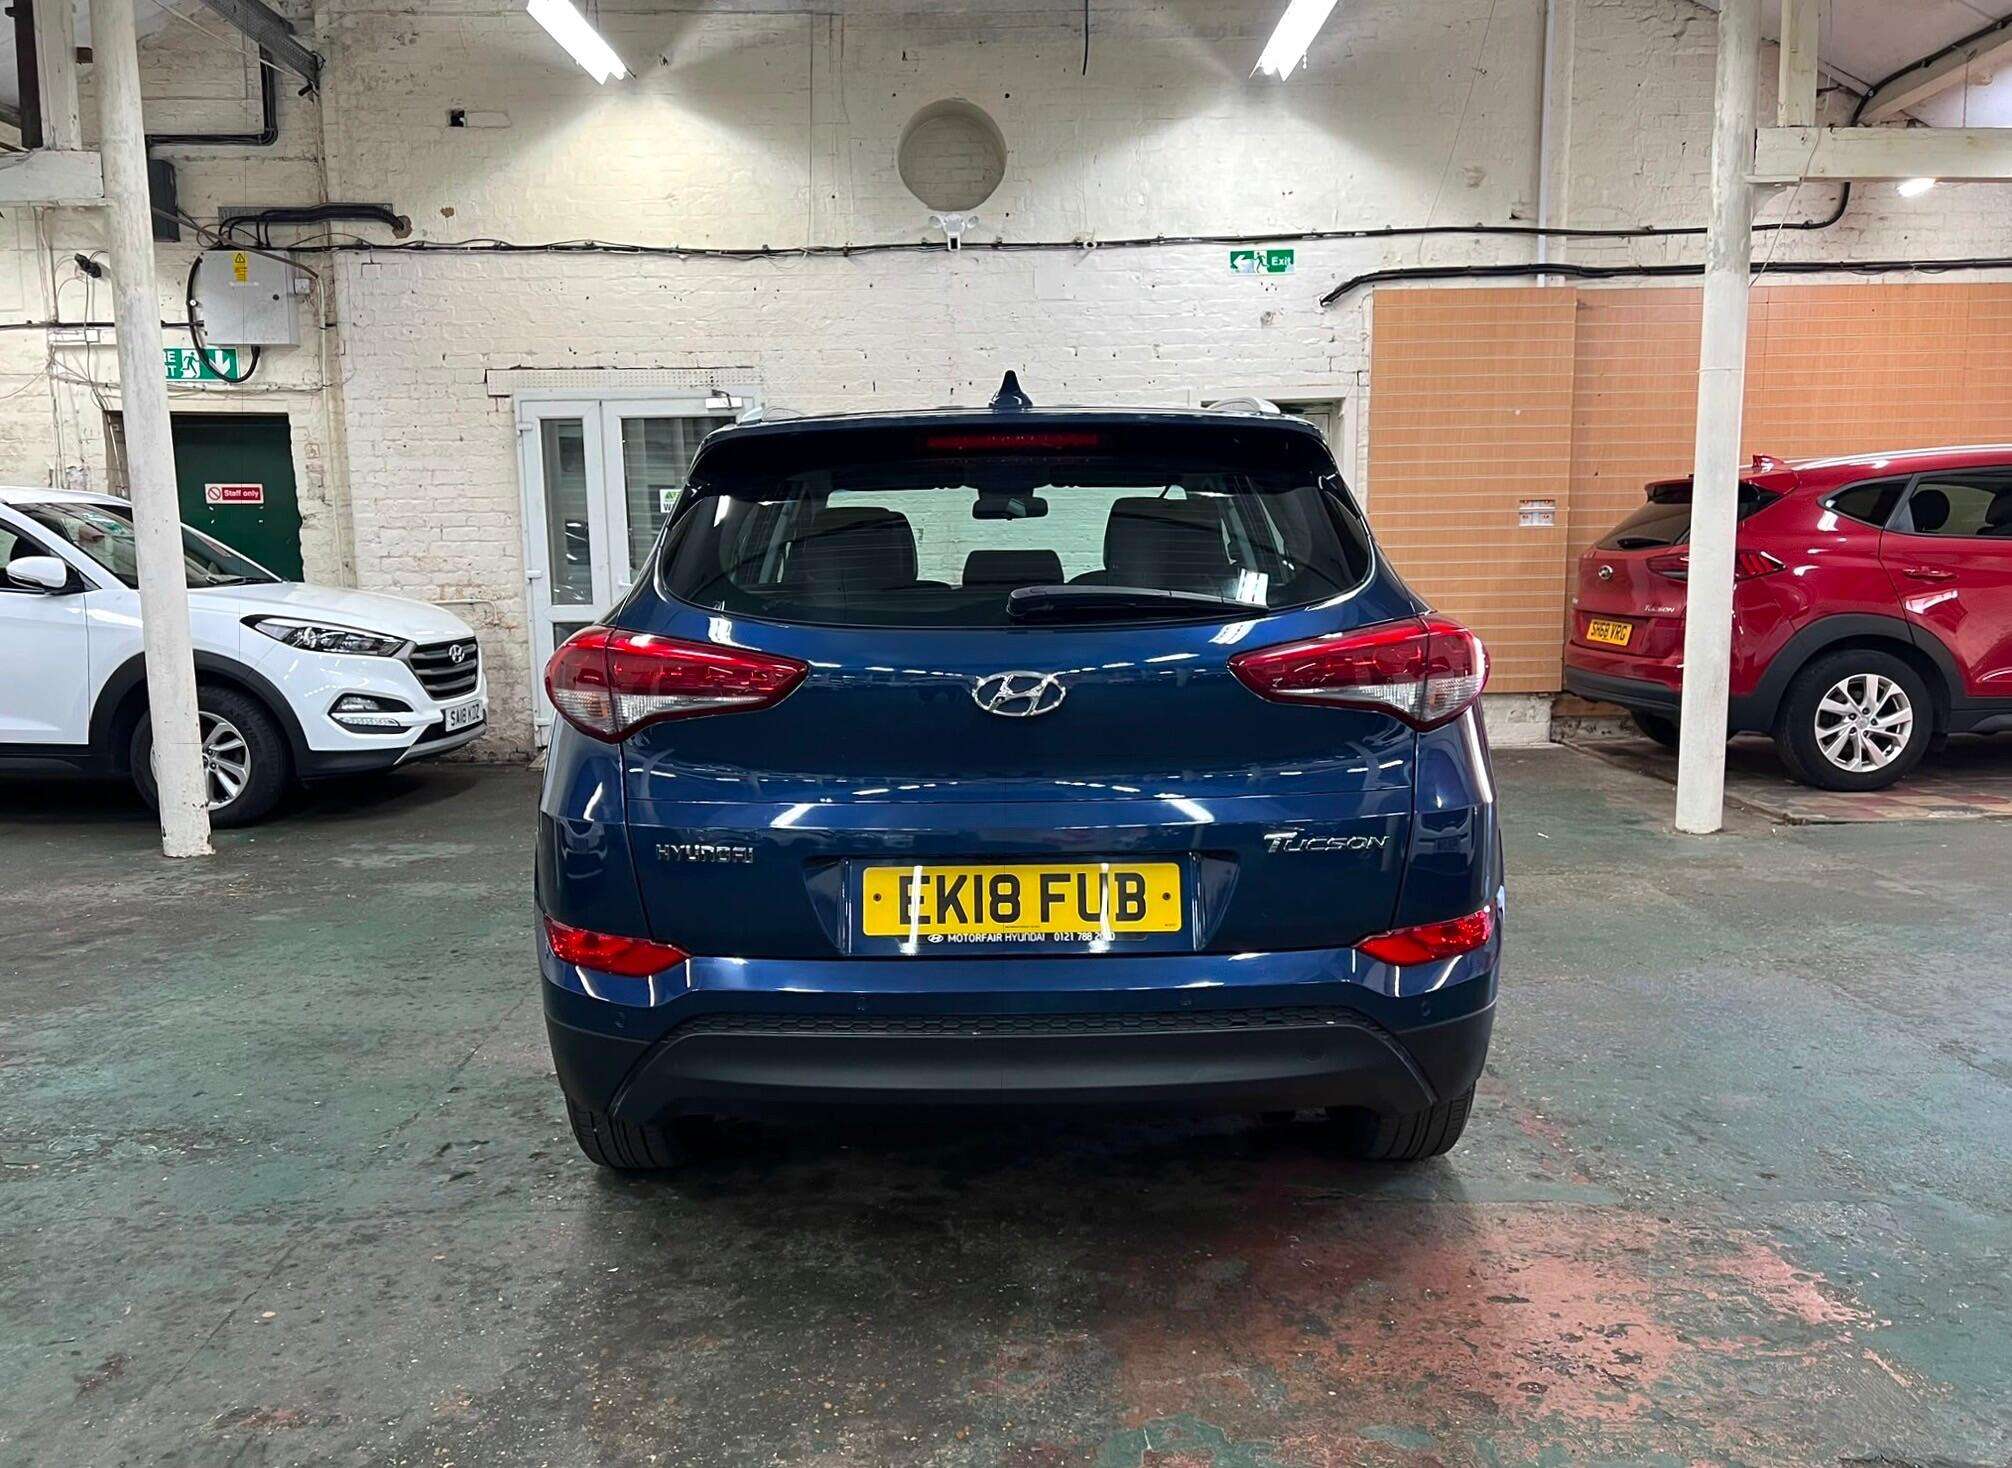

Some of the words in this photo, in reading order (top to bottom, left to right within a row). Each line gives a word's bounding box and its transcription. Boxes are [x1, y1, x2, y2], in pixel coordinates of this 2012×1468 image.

[1271, 256, 1291, 266] Exit
[224, 489, 242, 497] Staff
[243, 489, 259, 499] only
[1264, 832, 1390, 853] TUCSON
[656, 844, 753, 863] HYUNDAI
[899, 874, 1021, 925] EK18
[1040, 872, 1147, 923] FUB
[947, 932, 1002, 943] MOTORFAIR
[1005, 931, 1045, 942] HYUNDAI
[1053, 931, 1074, 941] 0121
[1077, 931, 1092, 941] 788
